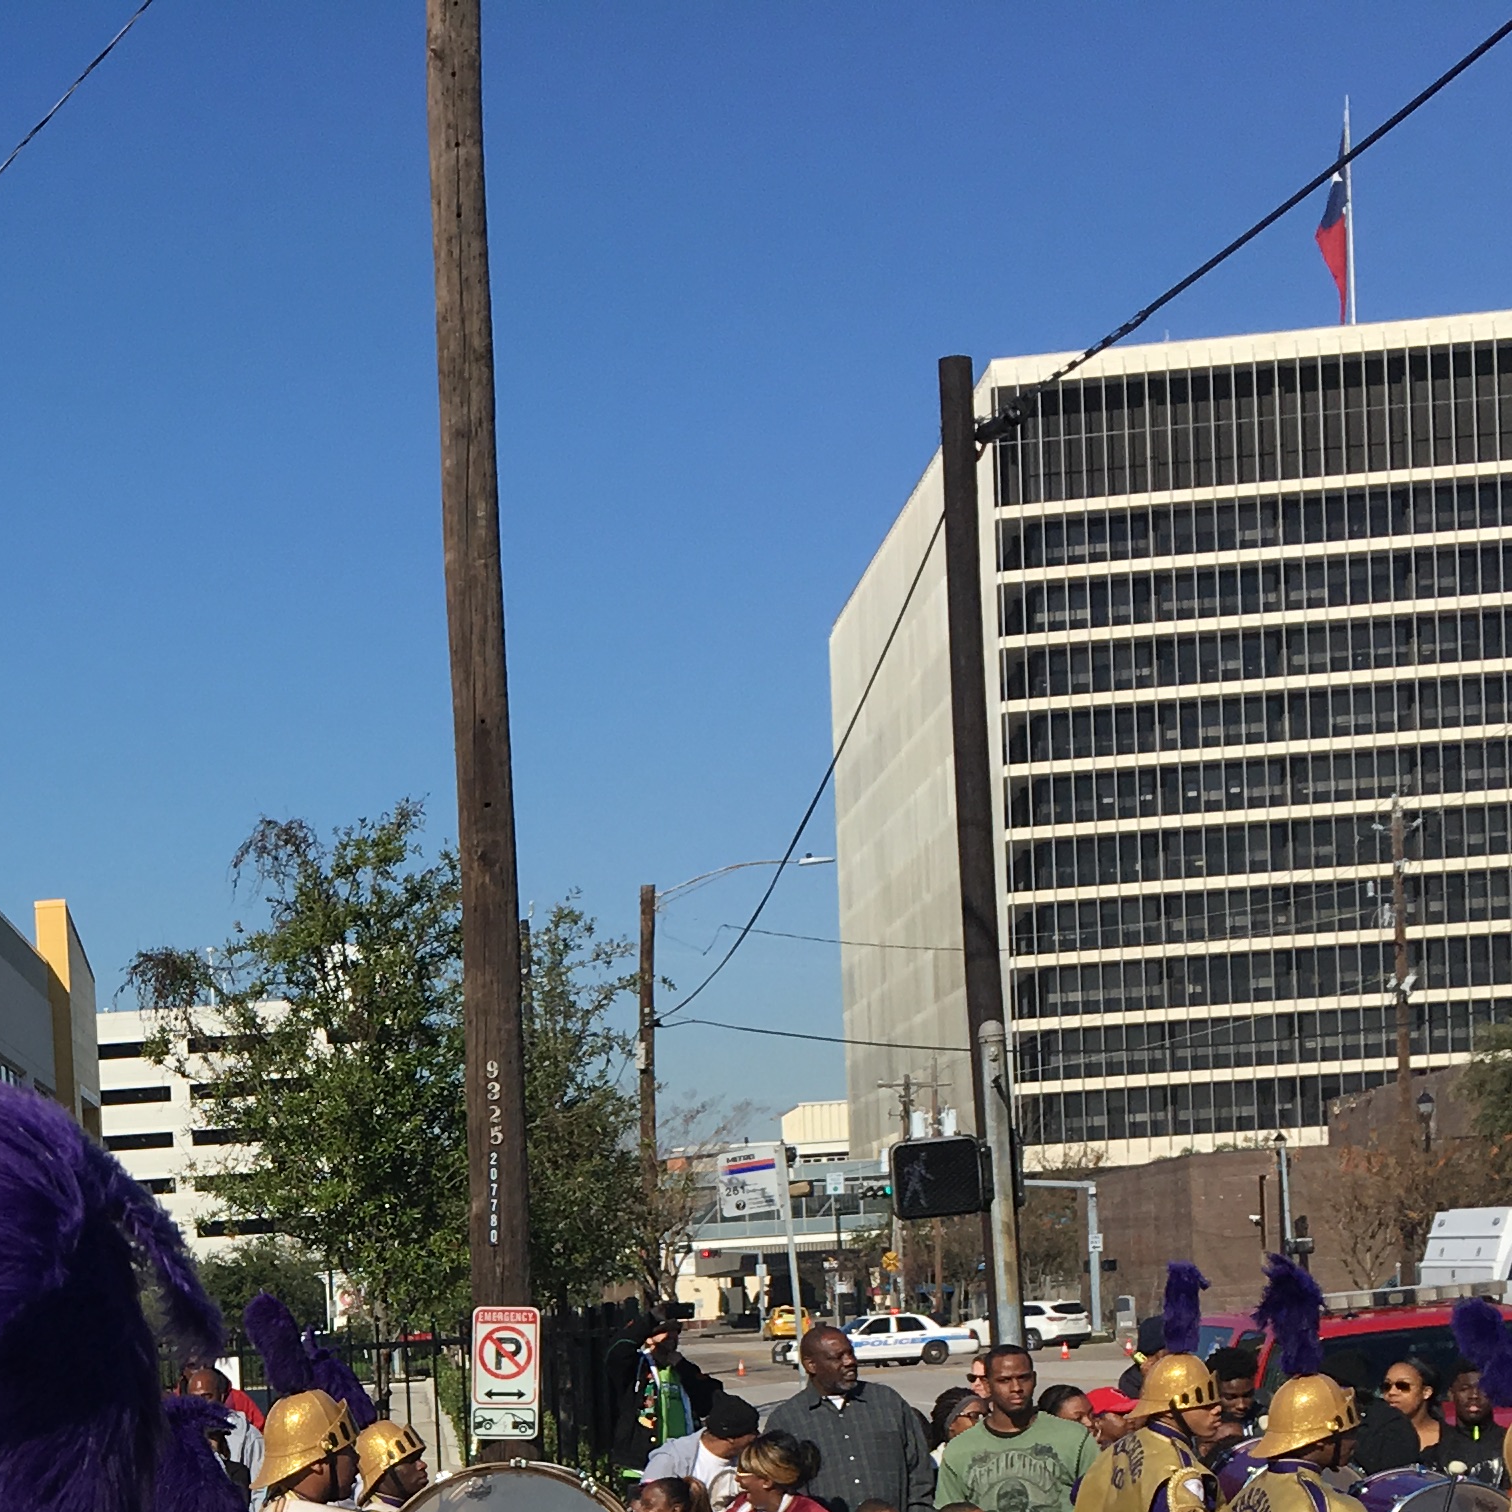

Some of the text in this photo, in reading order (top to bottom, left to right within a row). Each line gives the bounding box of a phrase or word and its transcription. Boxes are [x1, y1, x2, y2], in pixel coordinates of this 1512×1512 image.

[486, 1060, 504, 1146] 9325
[726, 1153, 755, 1164] METRO
[489, 1151, 499, 1244] 207780
[478, 1311, 535, 1323] EMERGENCY
[861, 1337, 922, 1347] POLICE
[968, 1450, 1061, 1489] AFFLICTION
